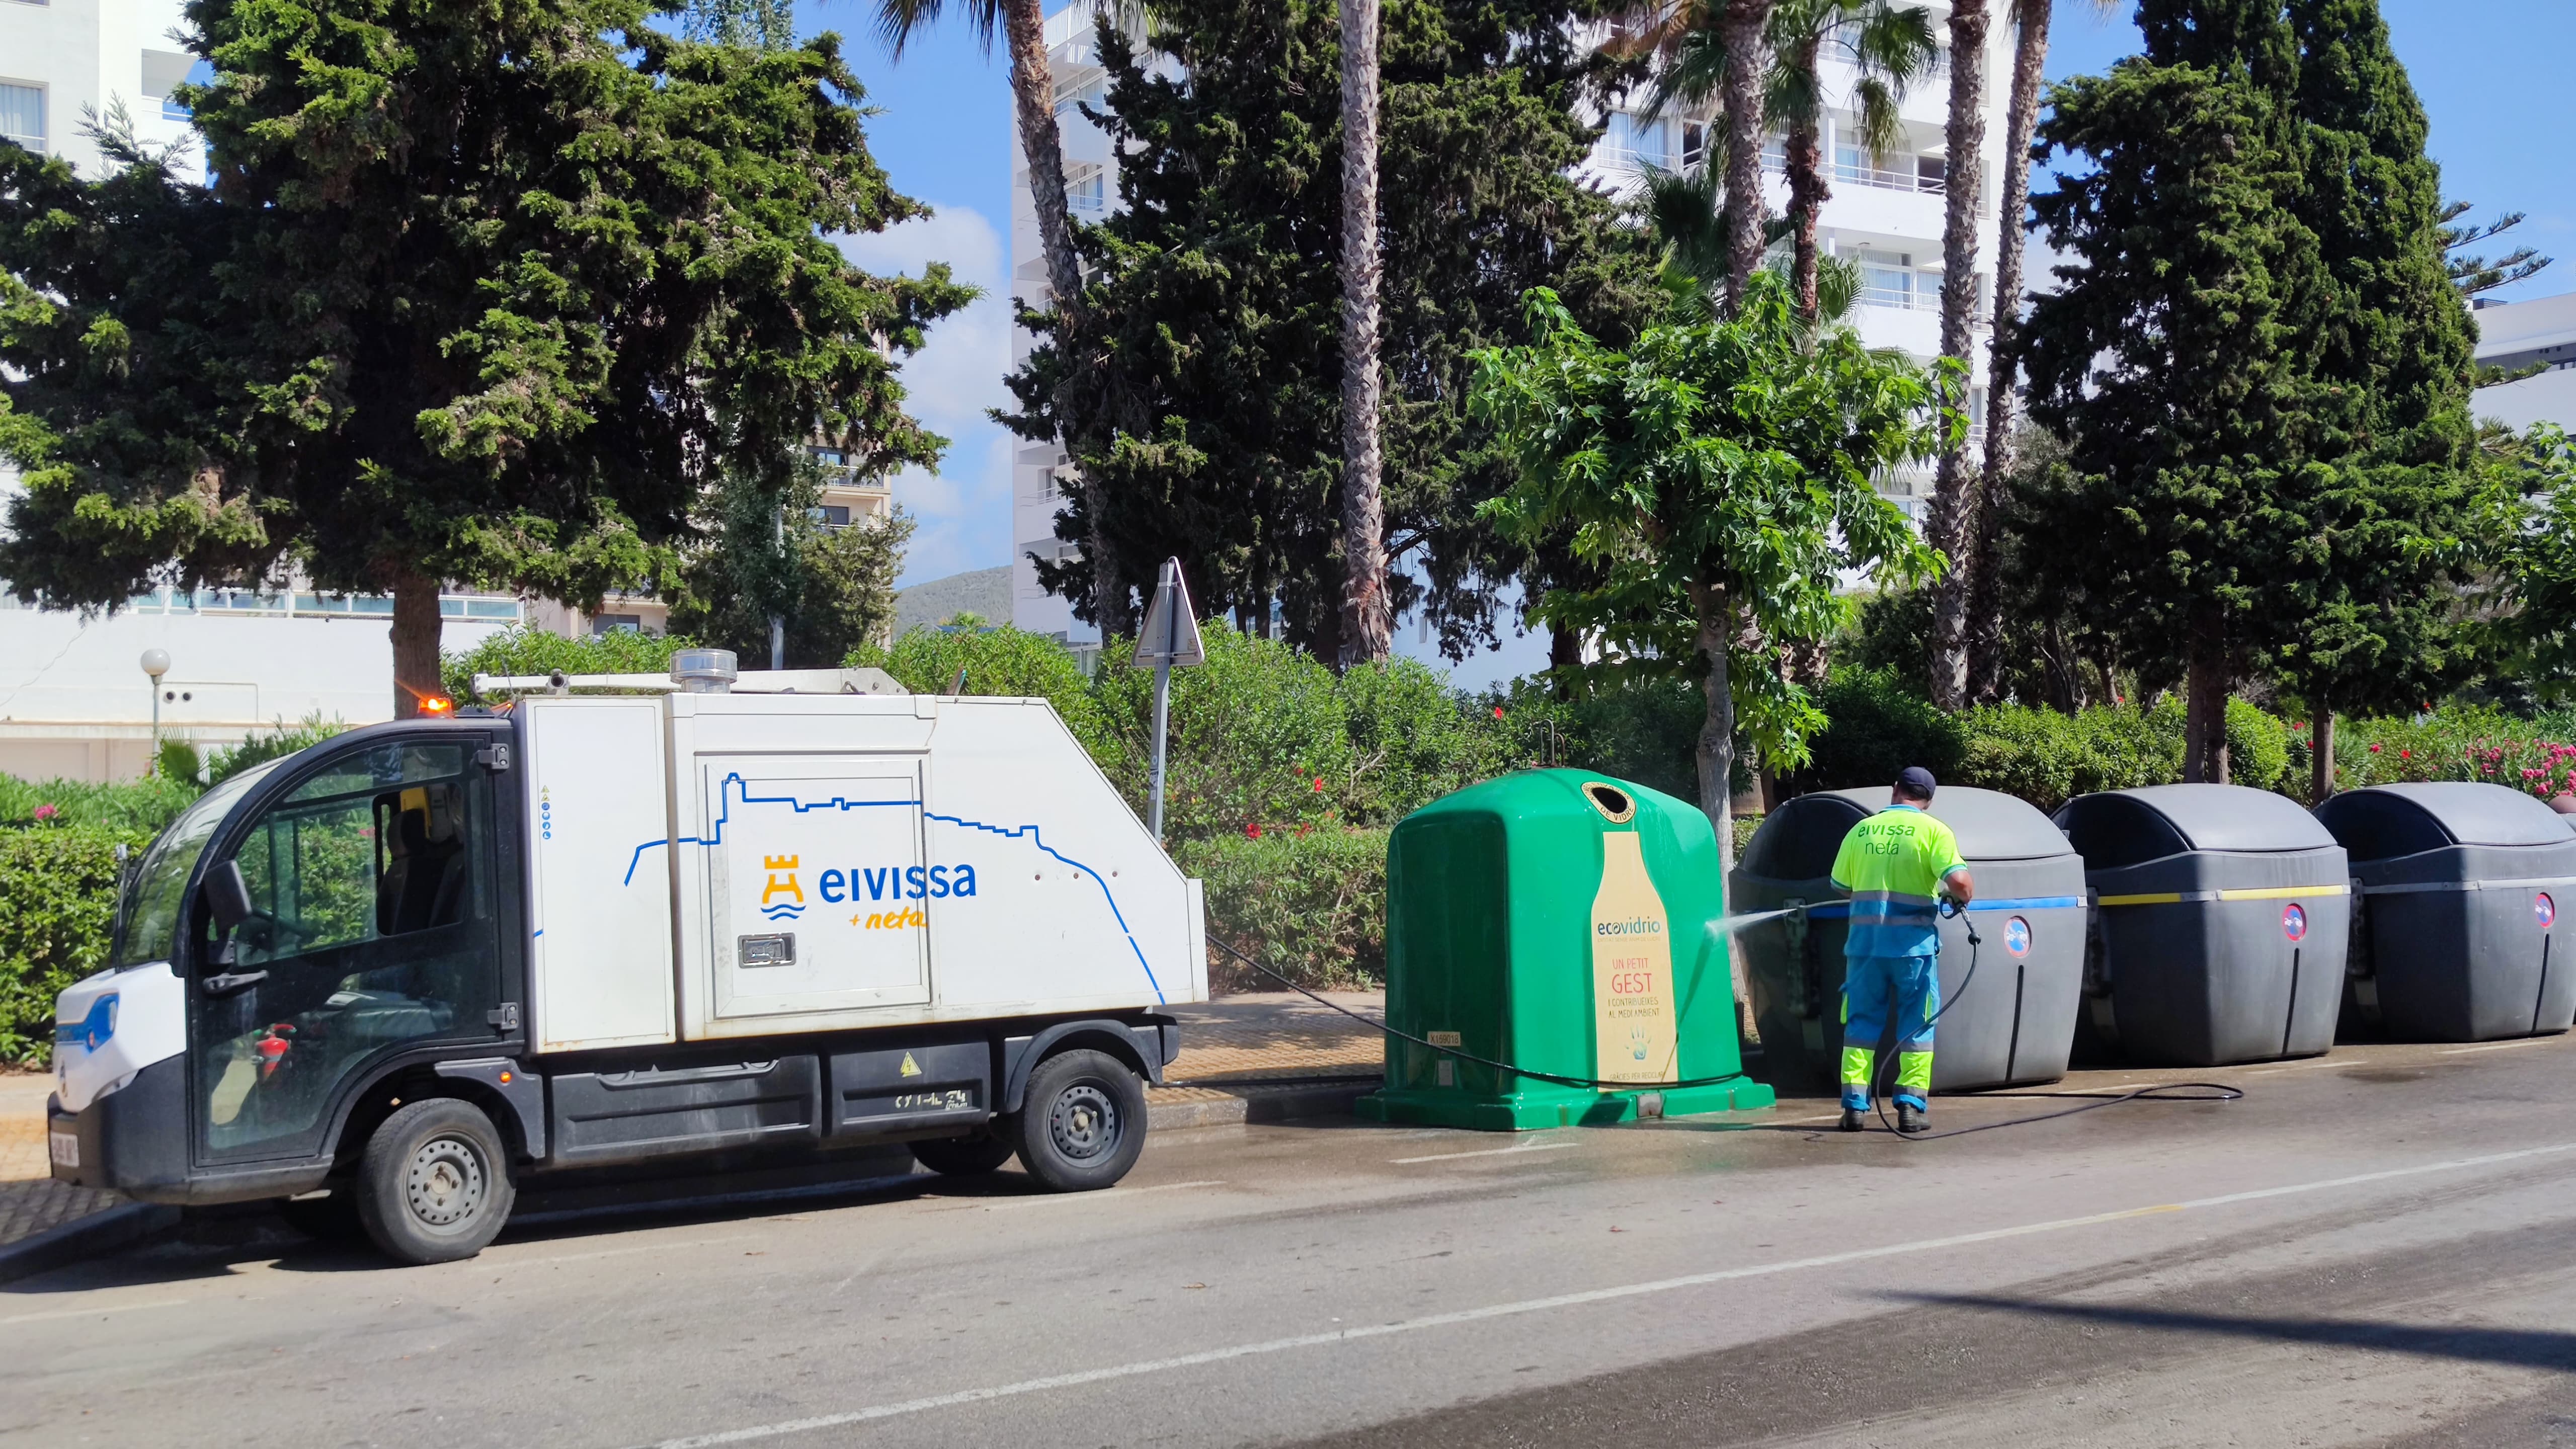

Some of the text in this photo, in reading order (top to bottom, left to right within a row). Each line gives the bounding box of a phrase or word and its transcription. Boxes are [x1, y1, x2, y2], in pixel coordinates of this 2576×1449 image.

[1600, 806, 1634, 821] DE VIDRE
[1858, 825, 1915, 837] eivissa
[1866, 841, 1899, 854] neta
[819, 864, 977, 903] eivissa
[865, 906, 930, 929] neta
[1597, 916, 1660, 935] ecovidrio
[1612, 957, 1648, 970] UN PETIT
[1612, 973, 1652, 993] GEST
[1608, 997, 1659, 1007] I CONTRIBUEIXES
[1608, 1008, 1659, 1018] AL MEDI AMBIENT
[1430, 1034, 1459, 1043] X169018
